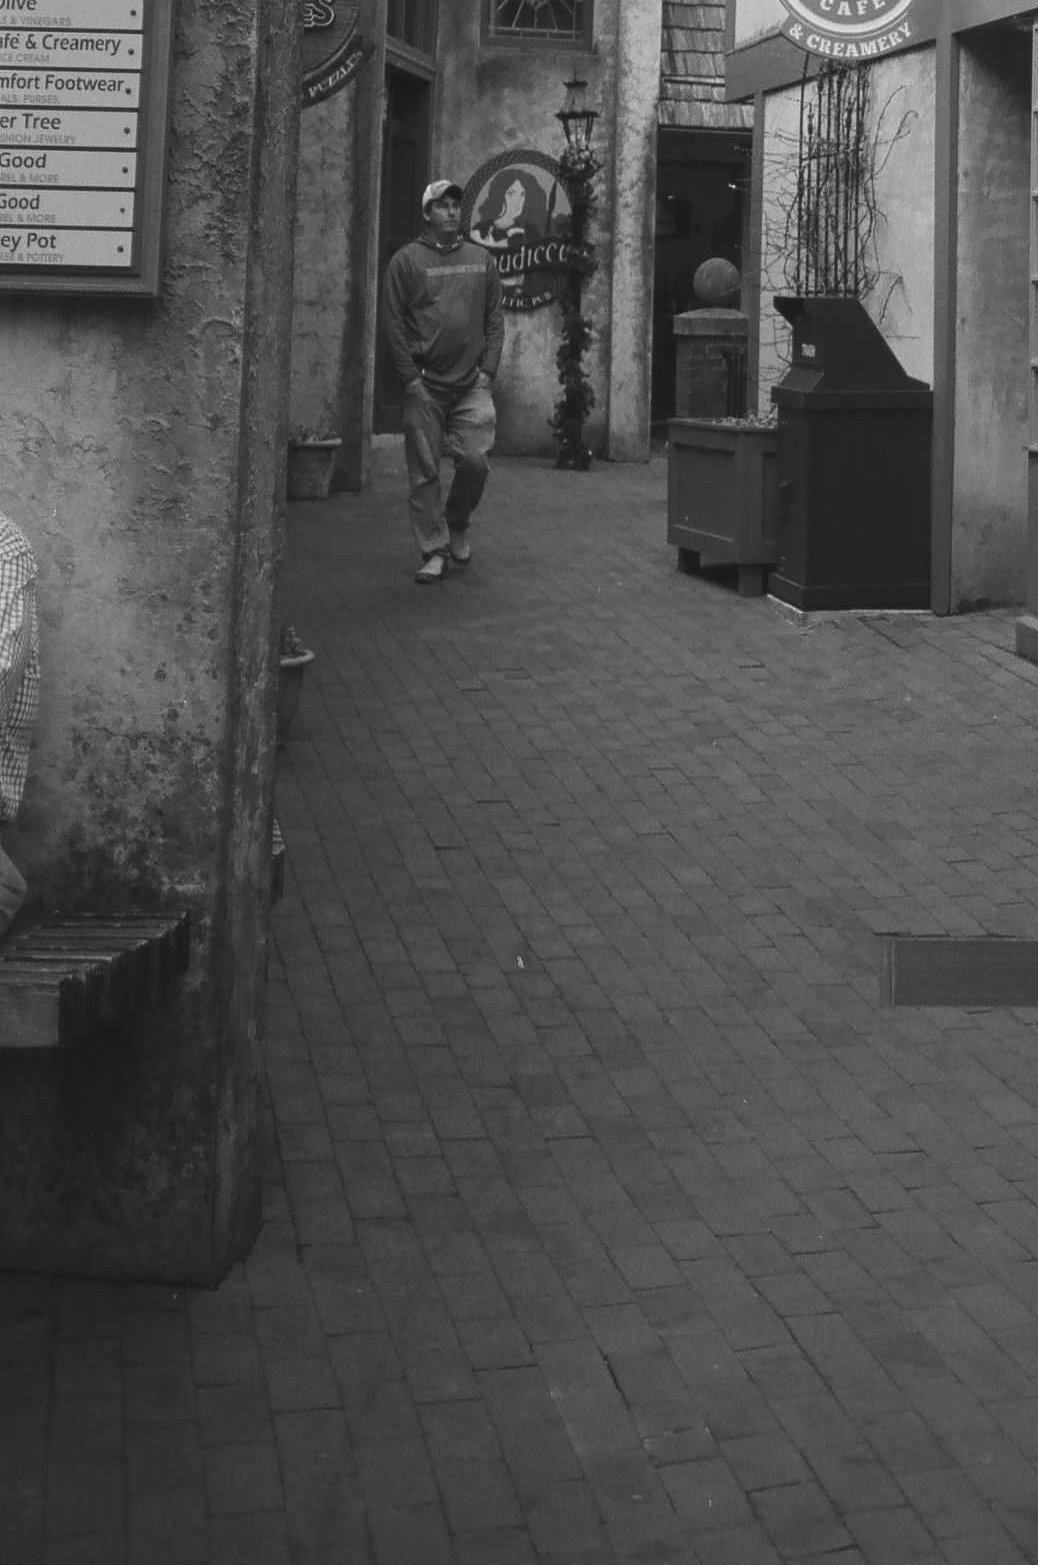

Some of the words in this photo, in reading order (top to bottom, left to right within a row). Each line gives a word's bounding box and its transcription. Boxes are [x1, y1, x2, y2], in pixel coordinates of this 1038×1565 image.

[20, 16, 71, 27] VINEGARS
[25, 34, 36, 50] &
[42, 34, 122, 56] Creamery
[789, 23, 803, 40] &
[806, 21, 911, 57] CREAMERY
[16, 53, 50, 63] CREAM
[45, 74, 125, 92] Footwear
[0, 116, 17, 128] er
[22, 113, 62, 130] Tree
[34, 134, 77, 145] JEWELRY
[0, 152, 47, 169] Good
[19, 173, 26, 183] &
[29, 174, 60, 184] MORE
[17, 214, 24, 223] &
[26, 214, 56, 224] MORE
[0, 234, 22, 253] ey
[27, 233, 57, 249] Pot
[26, 253, 65, 264] POTTERY
